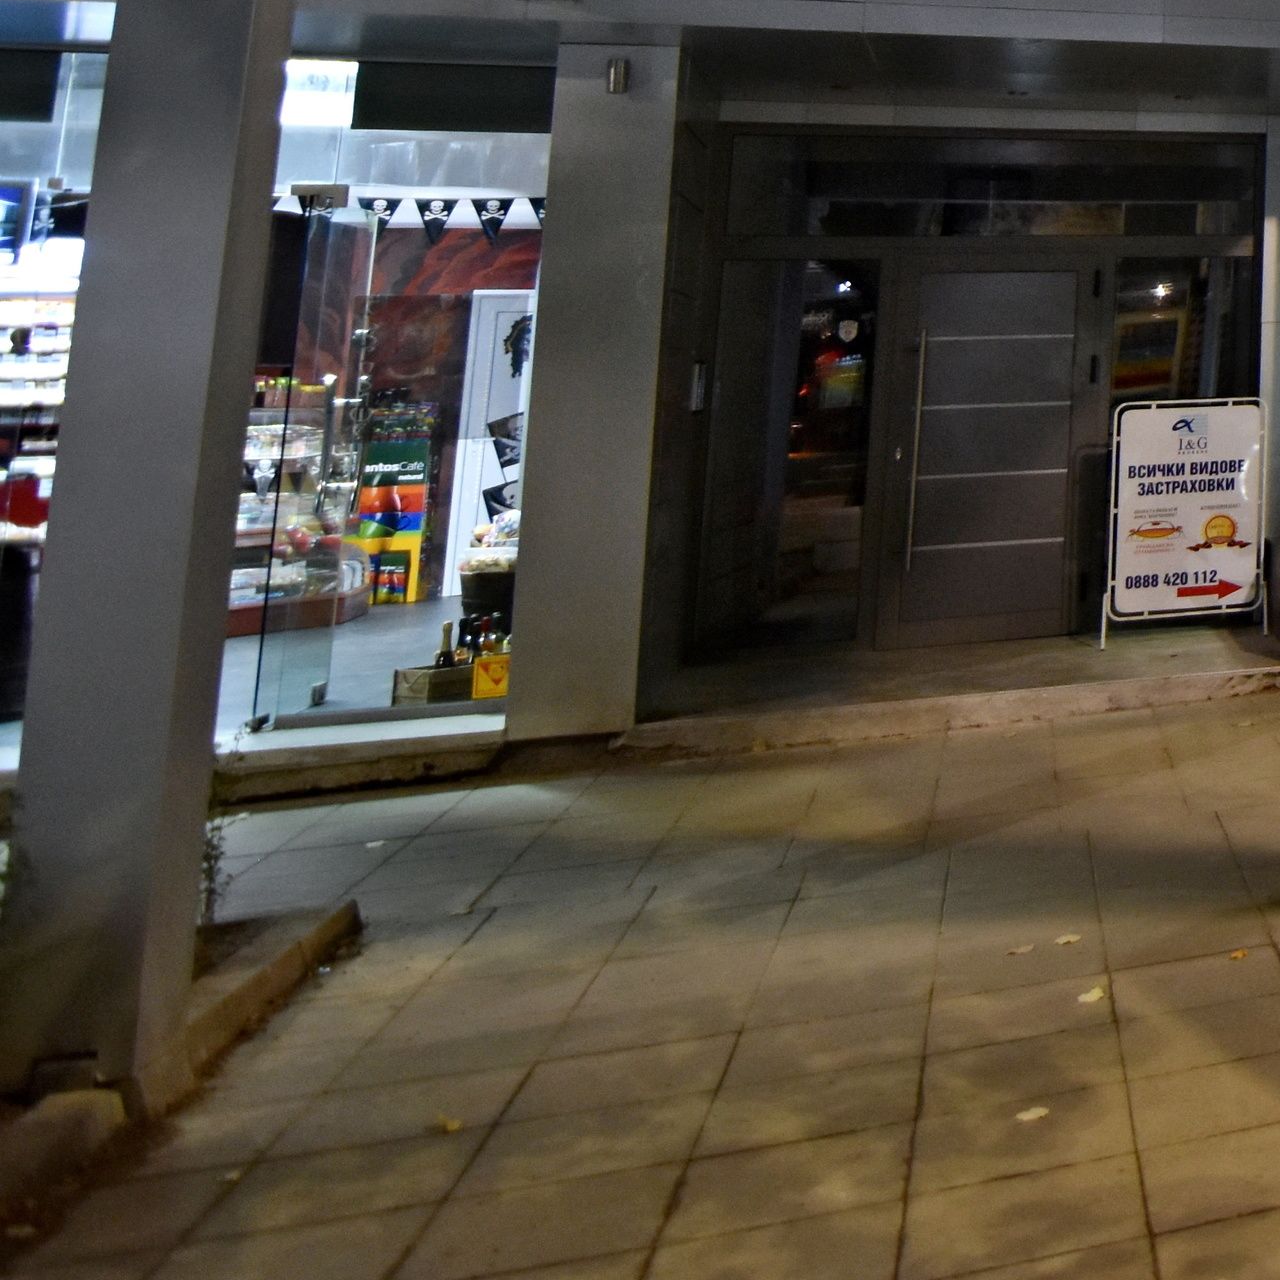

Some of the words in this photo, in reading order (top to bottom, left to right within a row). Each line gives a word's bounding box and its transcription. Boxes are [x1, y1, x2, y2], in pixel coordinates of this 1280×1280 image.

[1178, 436, 1208, 451] I&G
[364, 461, 424, 472] antosCafé
[1128, 463, 1186, 479] ВСИЧКИ
[1190, 459, 1245, 475] ВИДОВЕ
[1137, 478, 1235, 496] ЗАСТРАХОВКИ
[1125, 573, 1159, 590] 0888
[1163, 571, 1188, 587] 420
[1193, 570, 1218, 584] 112
